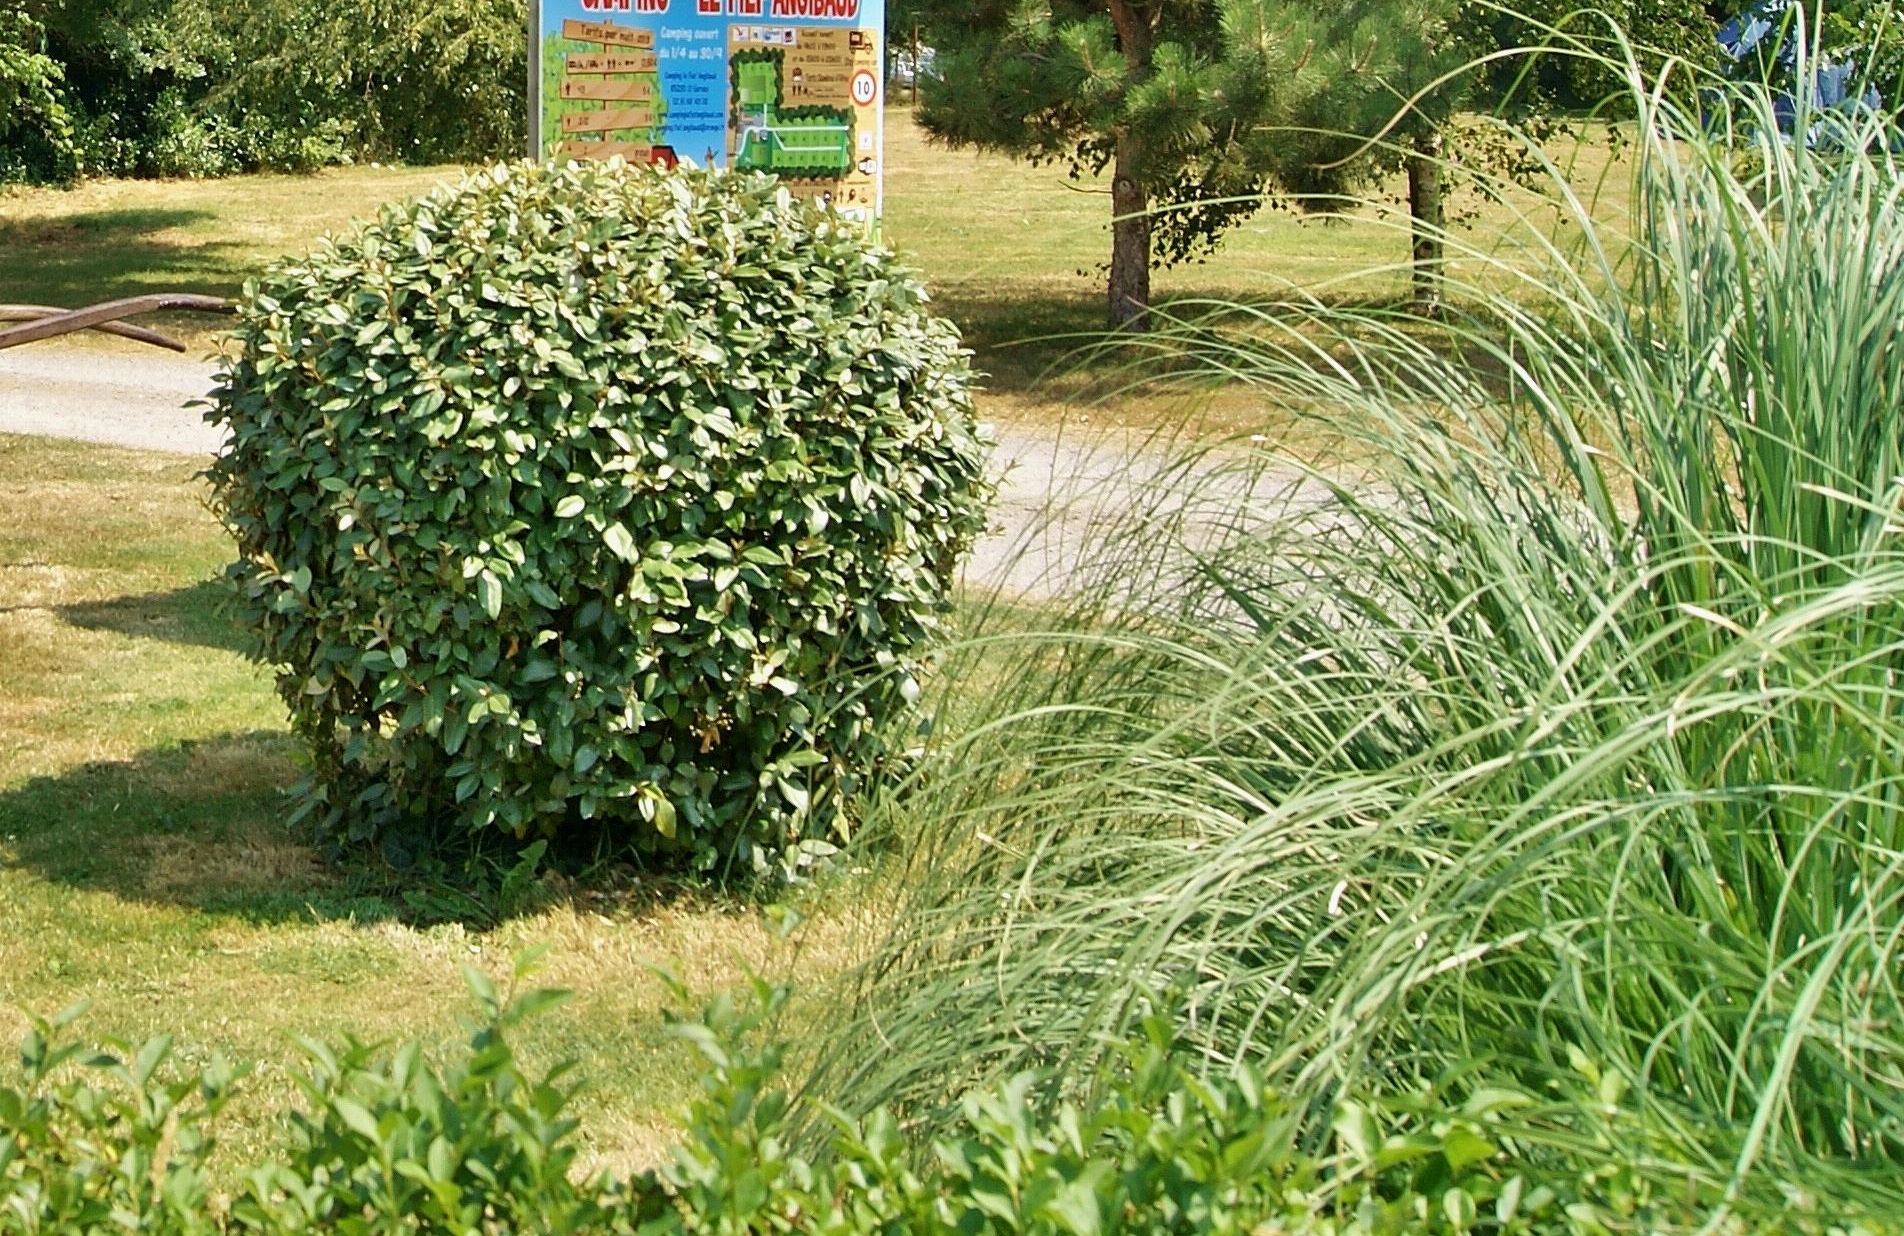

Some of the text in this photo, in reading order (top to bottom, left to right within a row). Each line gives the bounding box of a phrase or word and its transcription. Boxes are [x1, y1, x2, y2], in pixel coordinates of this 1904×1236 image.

[660, 26, 693, 42] Camping
[694, 28, 719, 40] ouvert
[857, 81, 870, 95] 10
